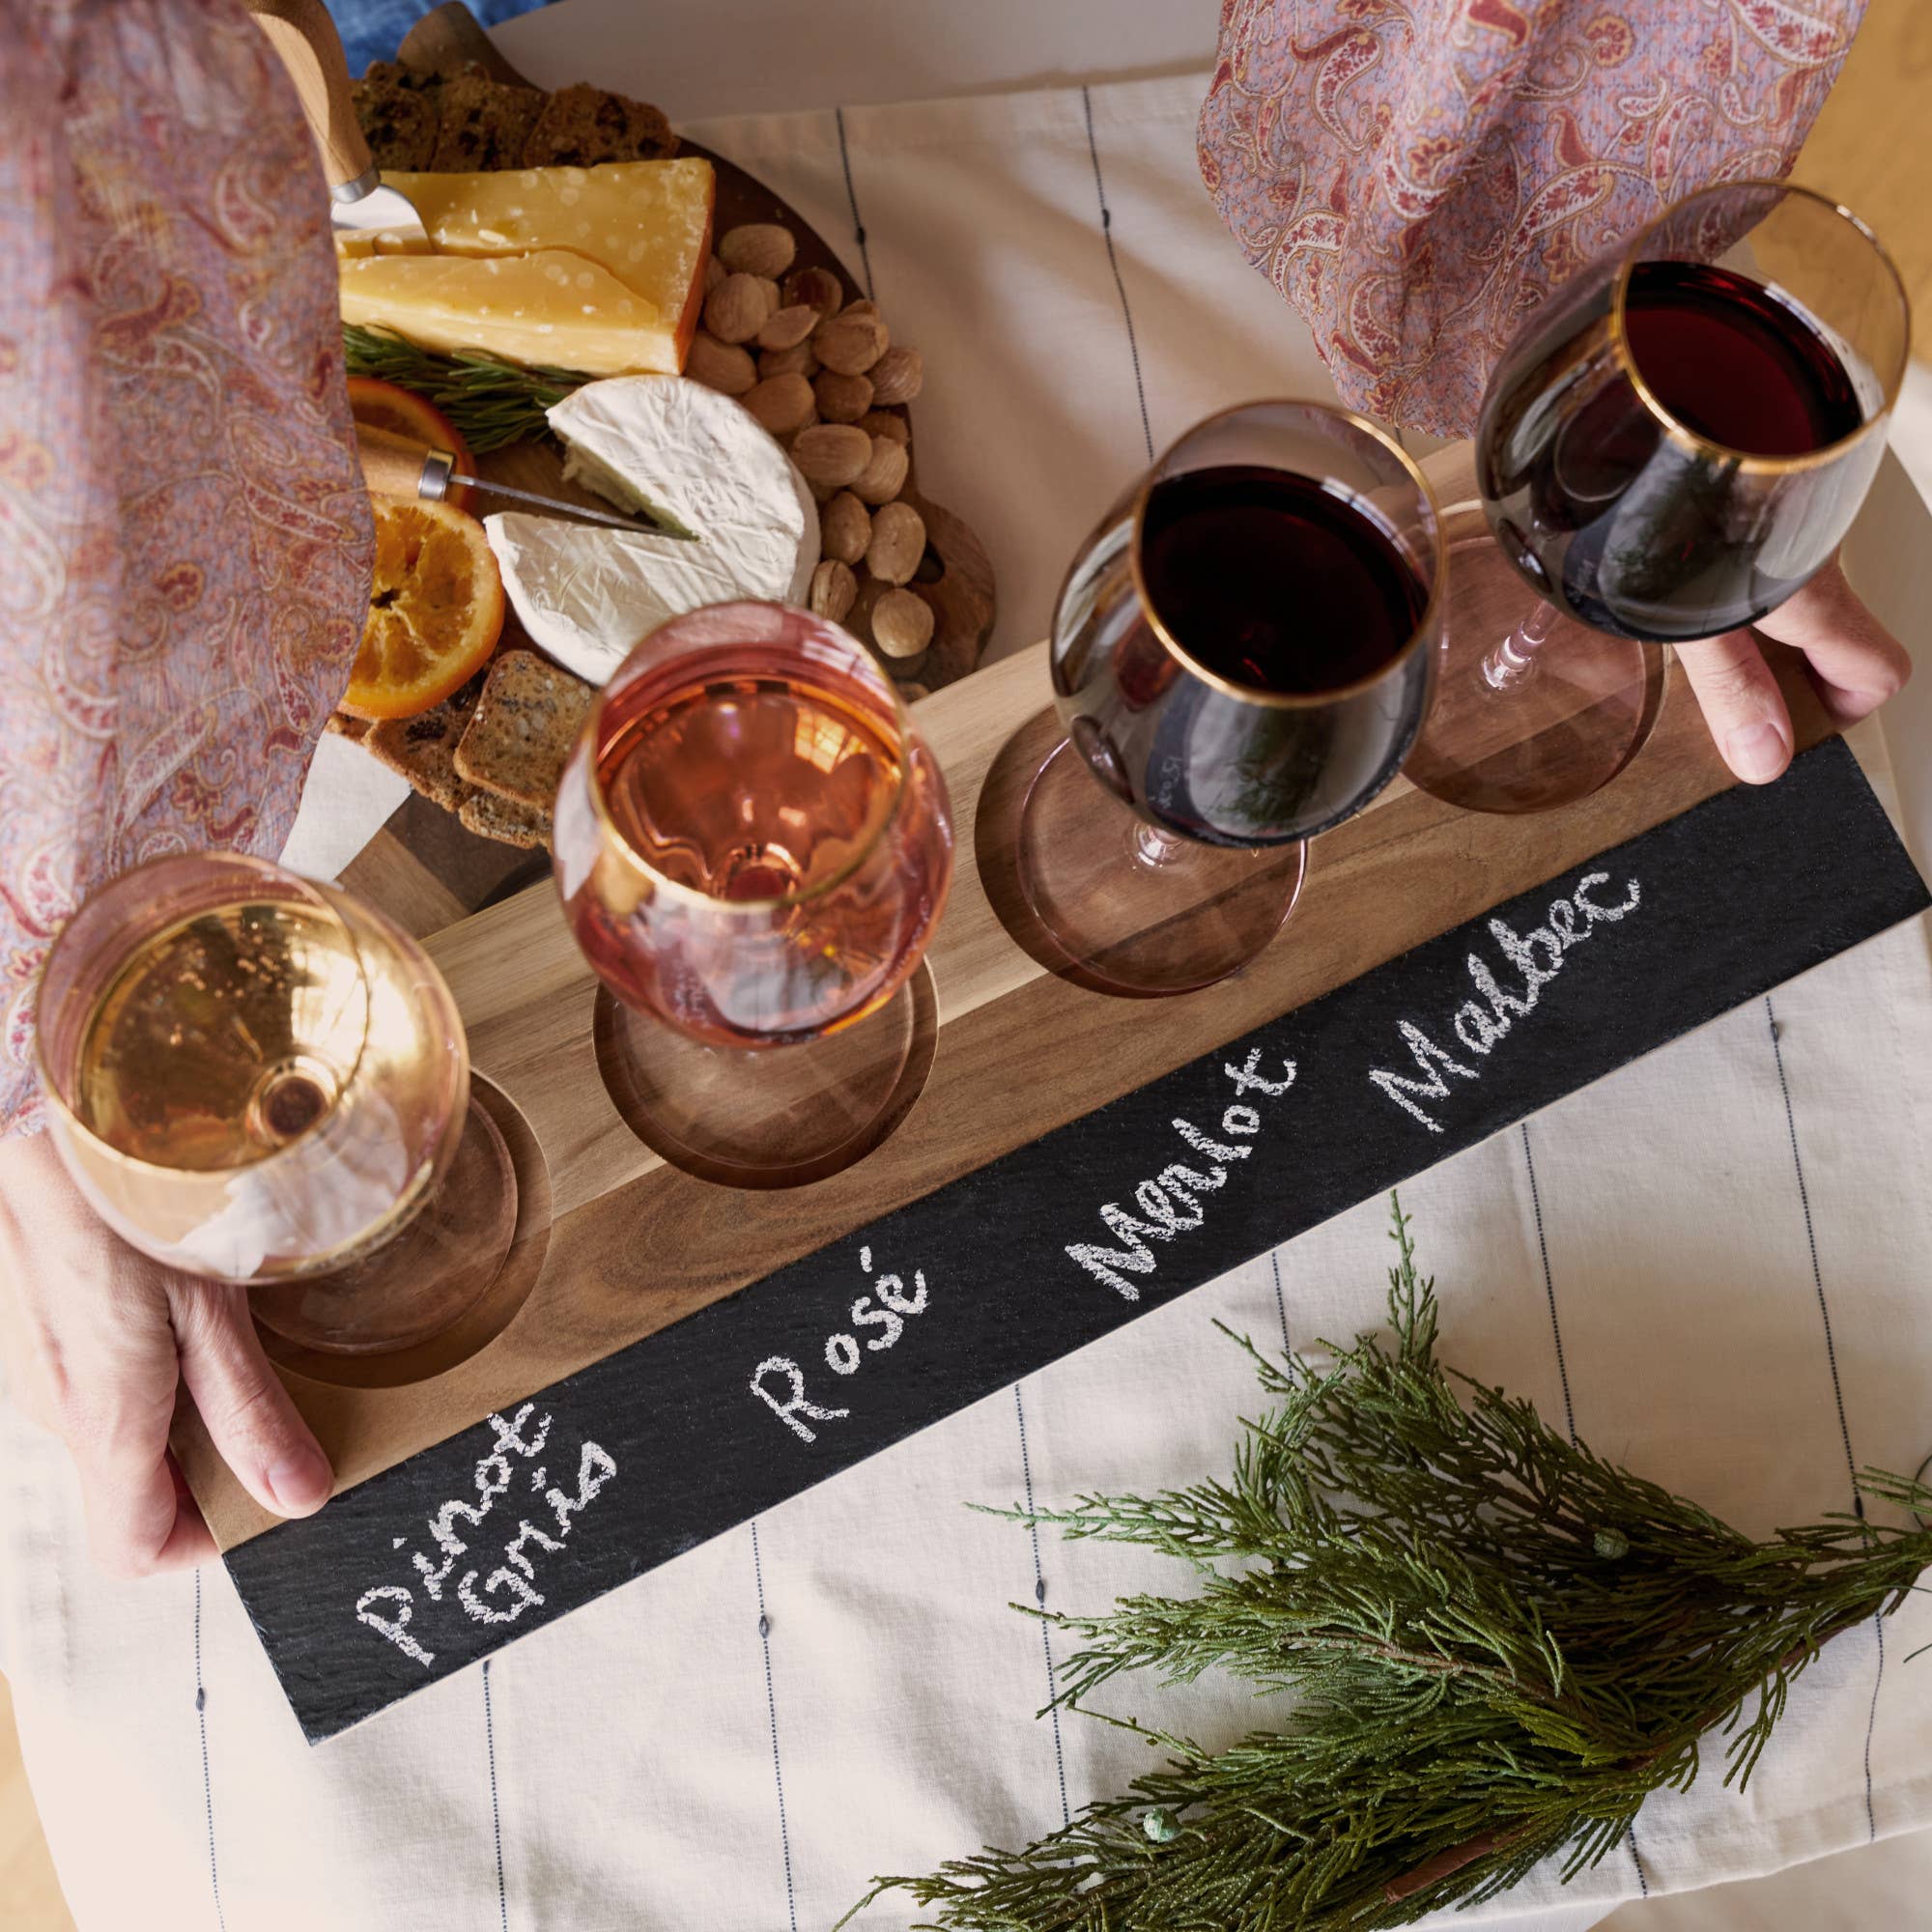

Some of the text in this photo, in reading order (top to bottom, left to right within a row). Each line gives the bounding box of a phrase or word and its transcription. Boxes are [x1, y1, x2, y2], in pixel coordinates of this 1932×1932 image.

[1368, 871, 1641, 1134] Malbec
[1064, 1048, 1297, 1302] Merlot
[749, 1245, 930, 1444] Rosé
[355, 1403, 554, 1668] Pinot
[457, 1439, 618, 1625] Gris
